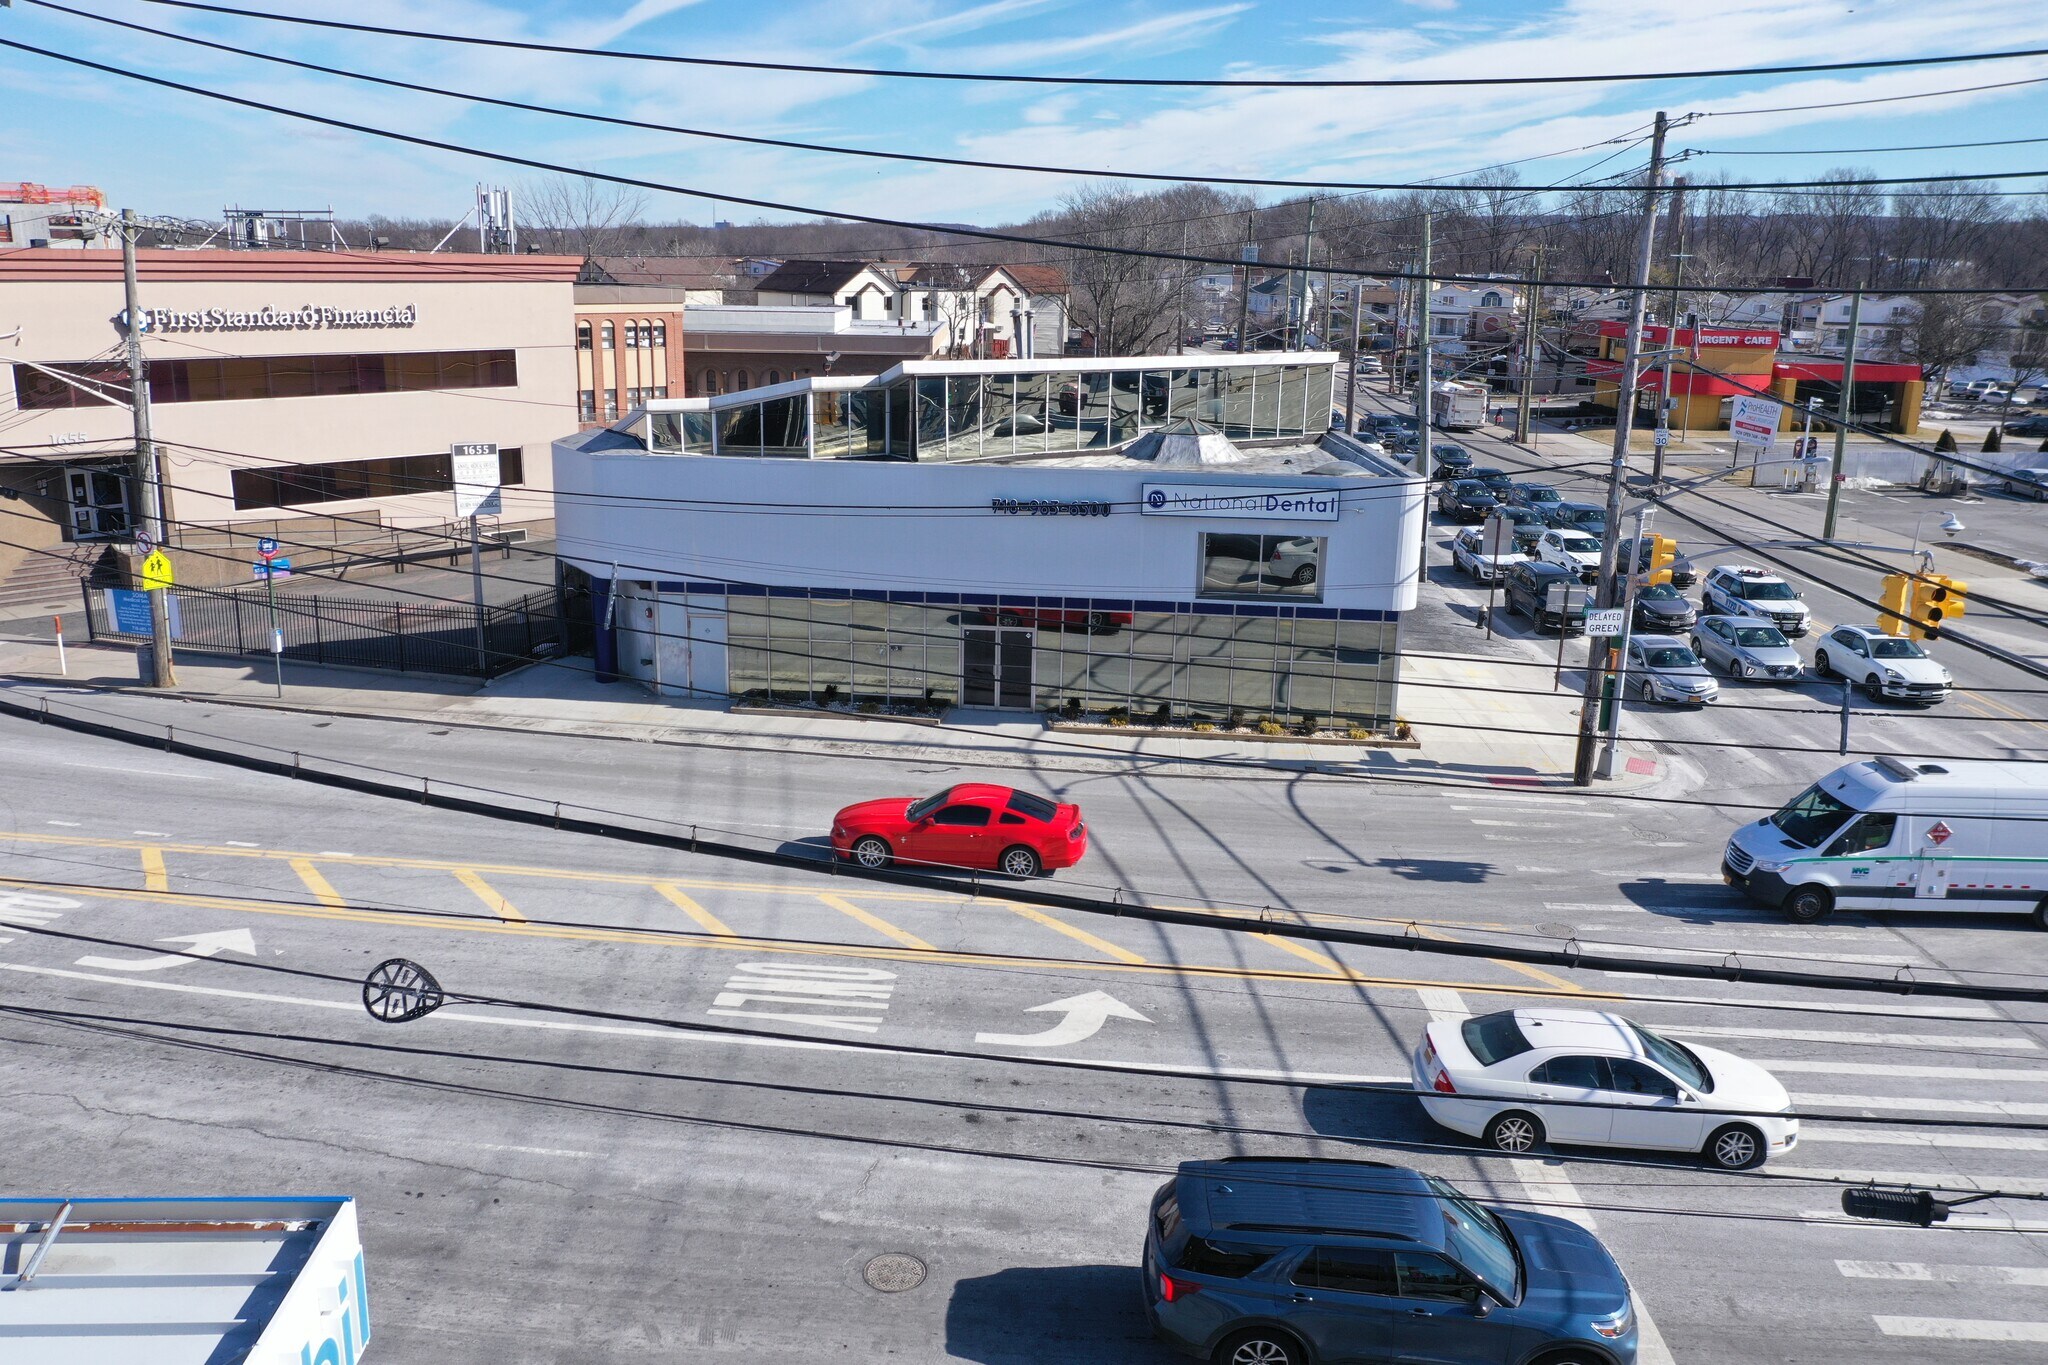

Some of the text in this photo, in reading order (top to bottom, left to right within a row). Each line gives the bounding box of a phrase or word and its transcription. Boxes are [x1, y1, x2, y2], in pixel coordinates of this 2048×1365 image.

[1744, 336, 1772, 345] CARE
[49, 432, 88, 445] 1655
[463, 445, 489, 455] 1655
[1590, 613, 1622, 621] DELAYED
[1589, 624, 1620, 632] GREEN
[1851, 867, 1870, 875] NYC
